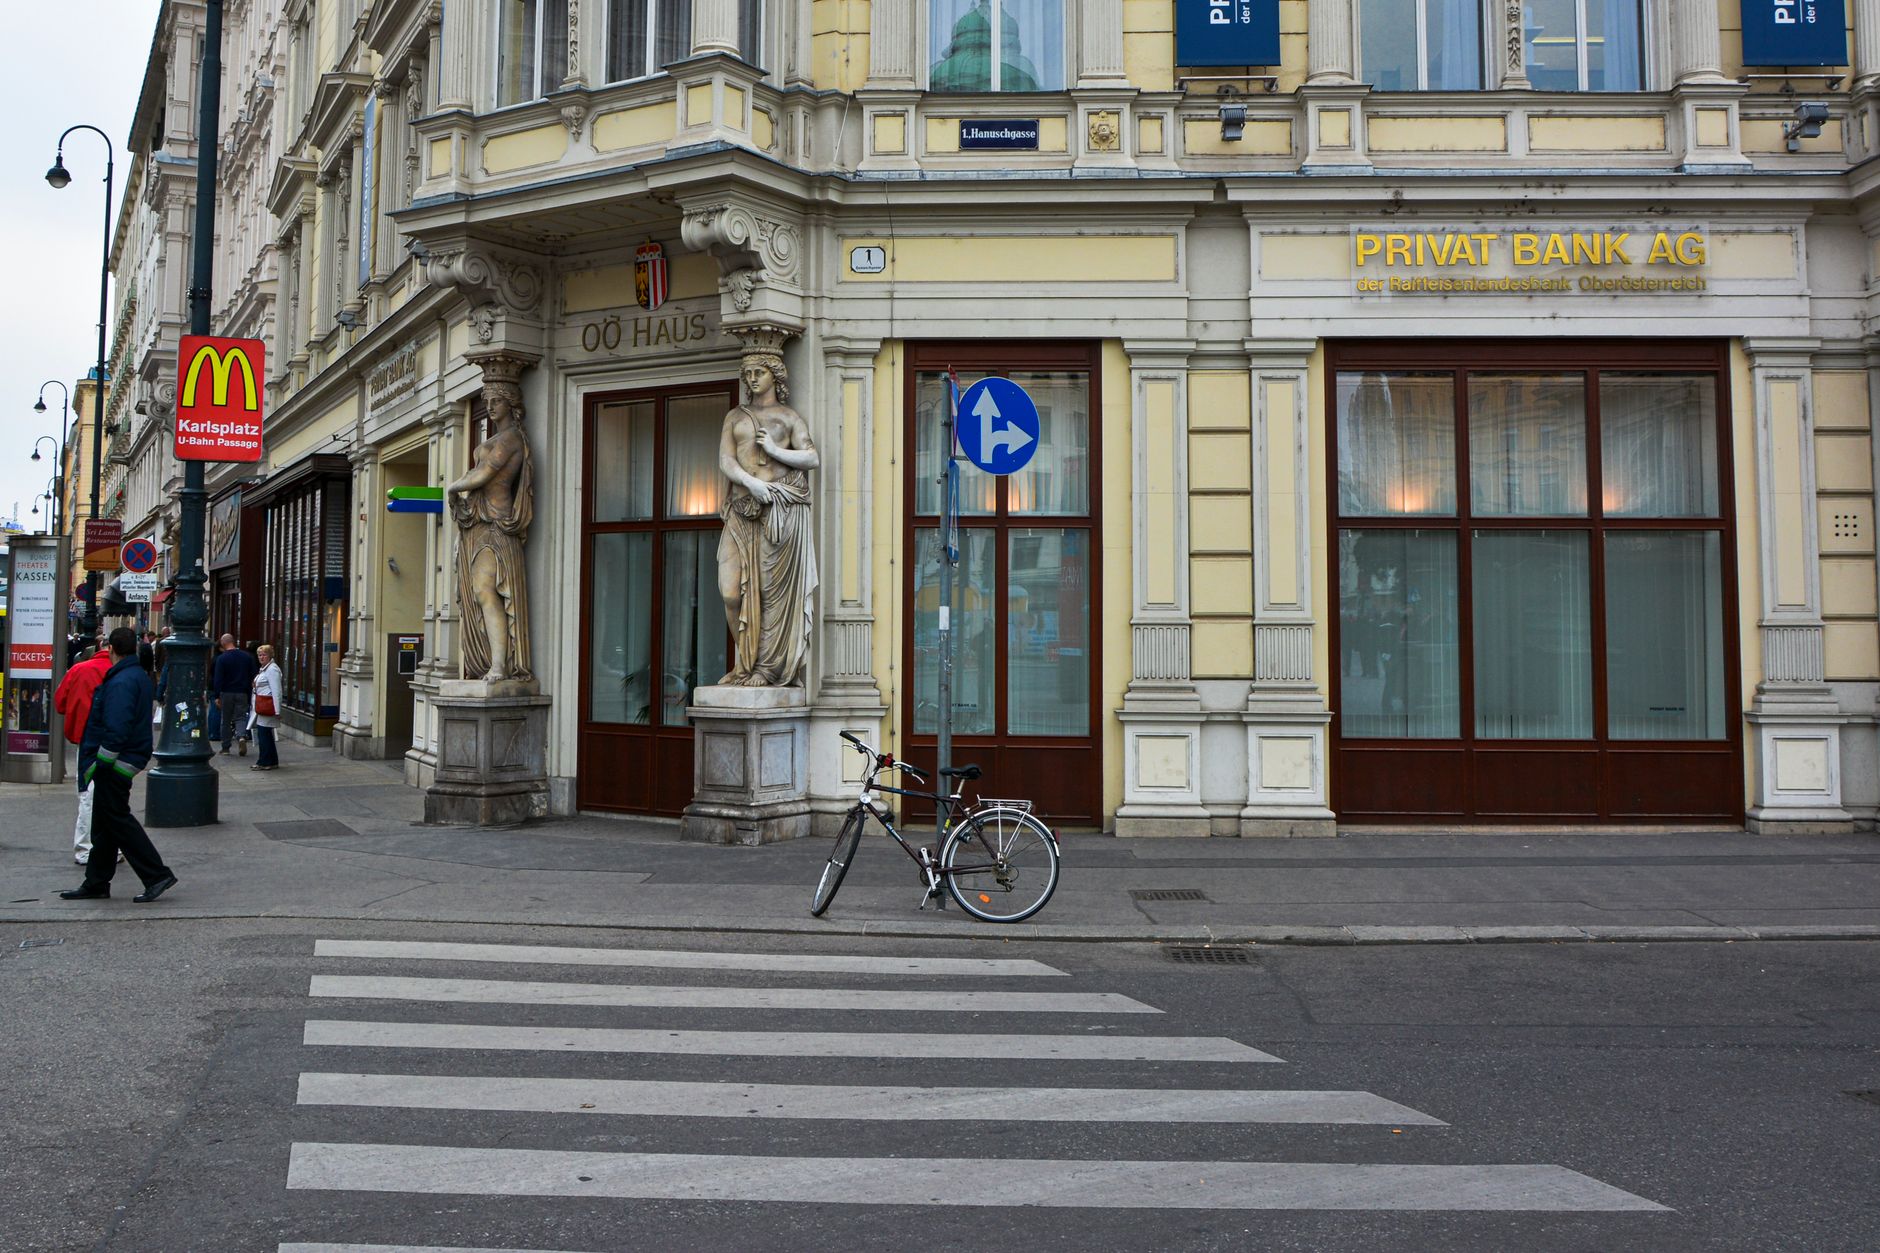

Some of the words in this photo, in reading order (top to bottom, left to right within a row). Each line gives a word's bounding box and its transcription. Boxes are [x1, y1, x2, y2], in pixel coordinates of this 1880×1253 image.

[1241, 5, 1251, 24] der
[1806, 5, 1816, 23] der
[865, 249, 873, 265] 1
[1356, 233, 1498, 266] PRIVAT
[1513, 232, 1632, 266] BANK
[1647, 232, 1706, 266] AG
[1357, 276, 1384, 292] der
[1389, 275, 1573, 292] Raiffeisenlandesbank
[1578, 274, 1707, 291] Oberösterreich
[582, 316, 622, 352] OÖ
[633, 314, 706, 348] HAUS
[178, 419, 260, 437] Karlsplatz
[178, 436, 214, 446] U-Bahn
[217, 437, 259, 449] Passage
[98, 529, 120, 537] Lanka
[15, 572, 56, 581] KASSEN
[128, 593, 148, 601] Anfang
[12, 652, 46, 662] TICKETS
